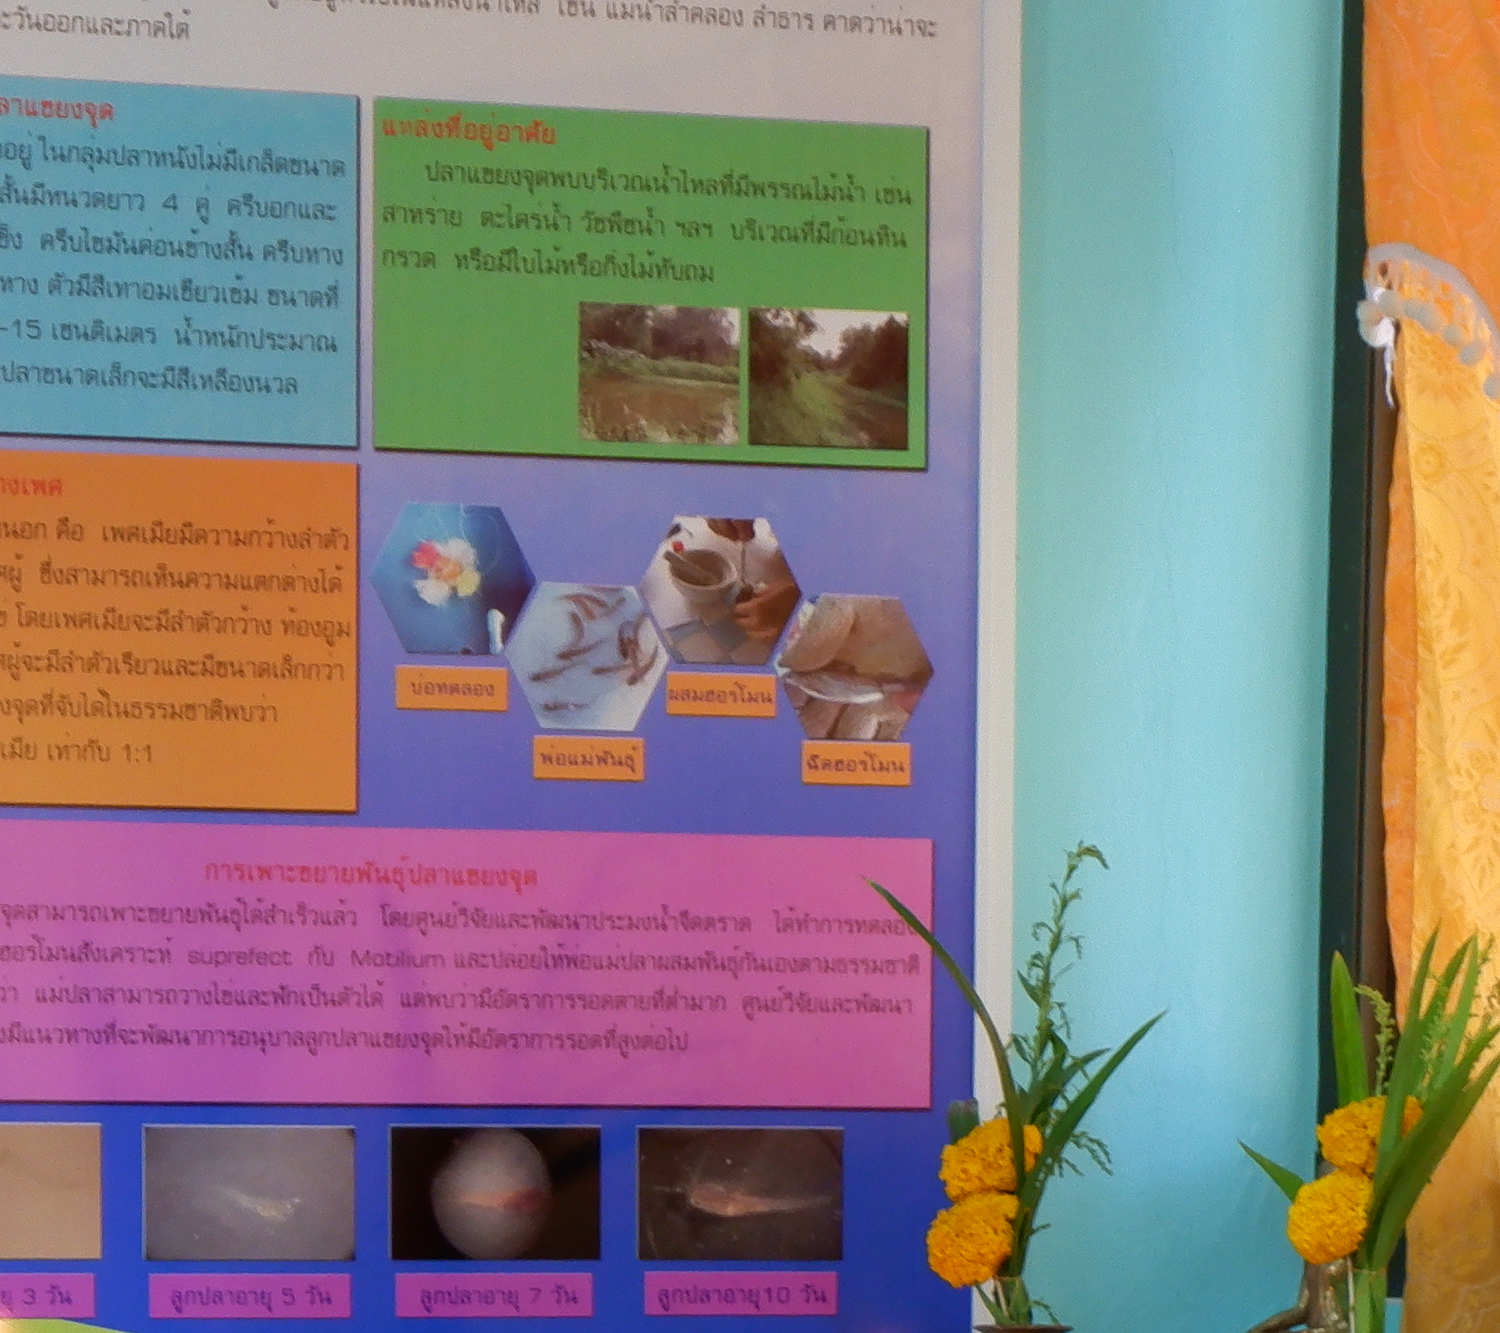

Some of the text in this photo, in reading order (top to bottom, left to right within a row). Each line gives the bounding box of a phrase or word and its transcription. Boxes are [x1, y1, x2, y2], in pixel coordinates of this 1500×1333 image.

[162, 193, 179, 213] 4
[21, 1286, 38, 1306] 3
[281, 1286, 296, 1307] 5
[528, 1286, 542, 1306] 7
